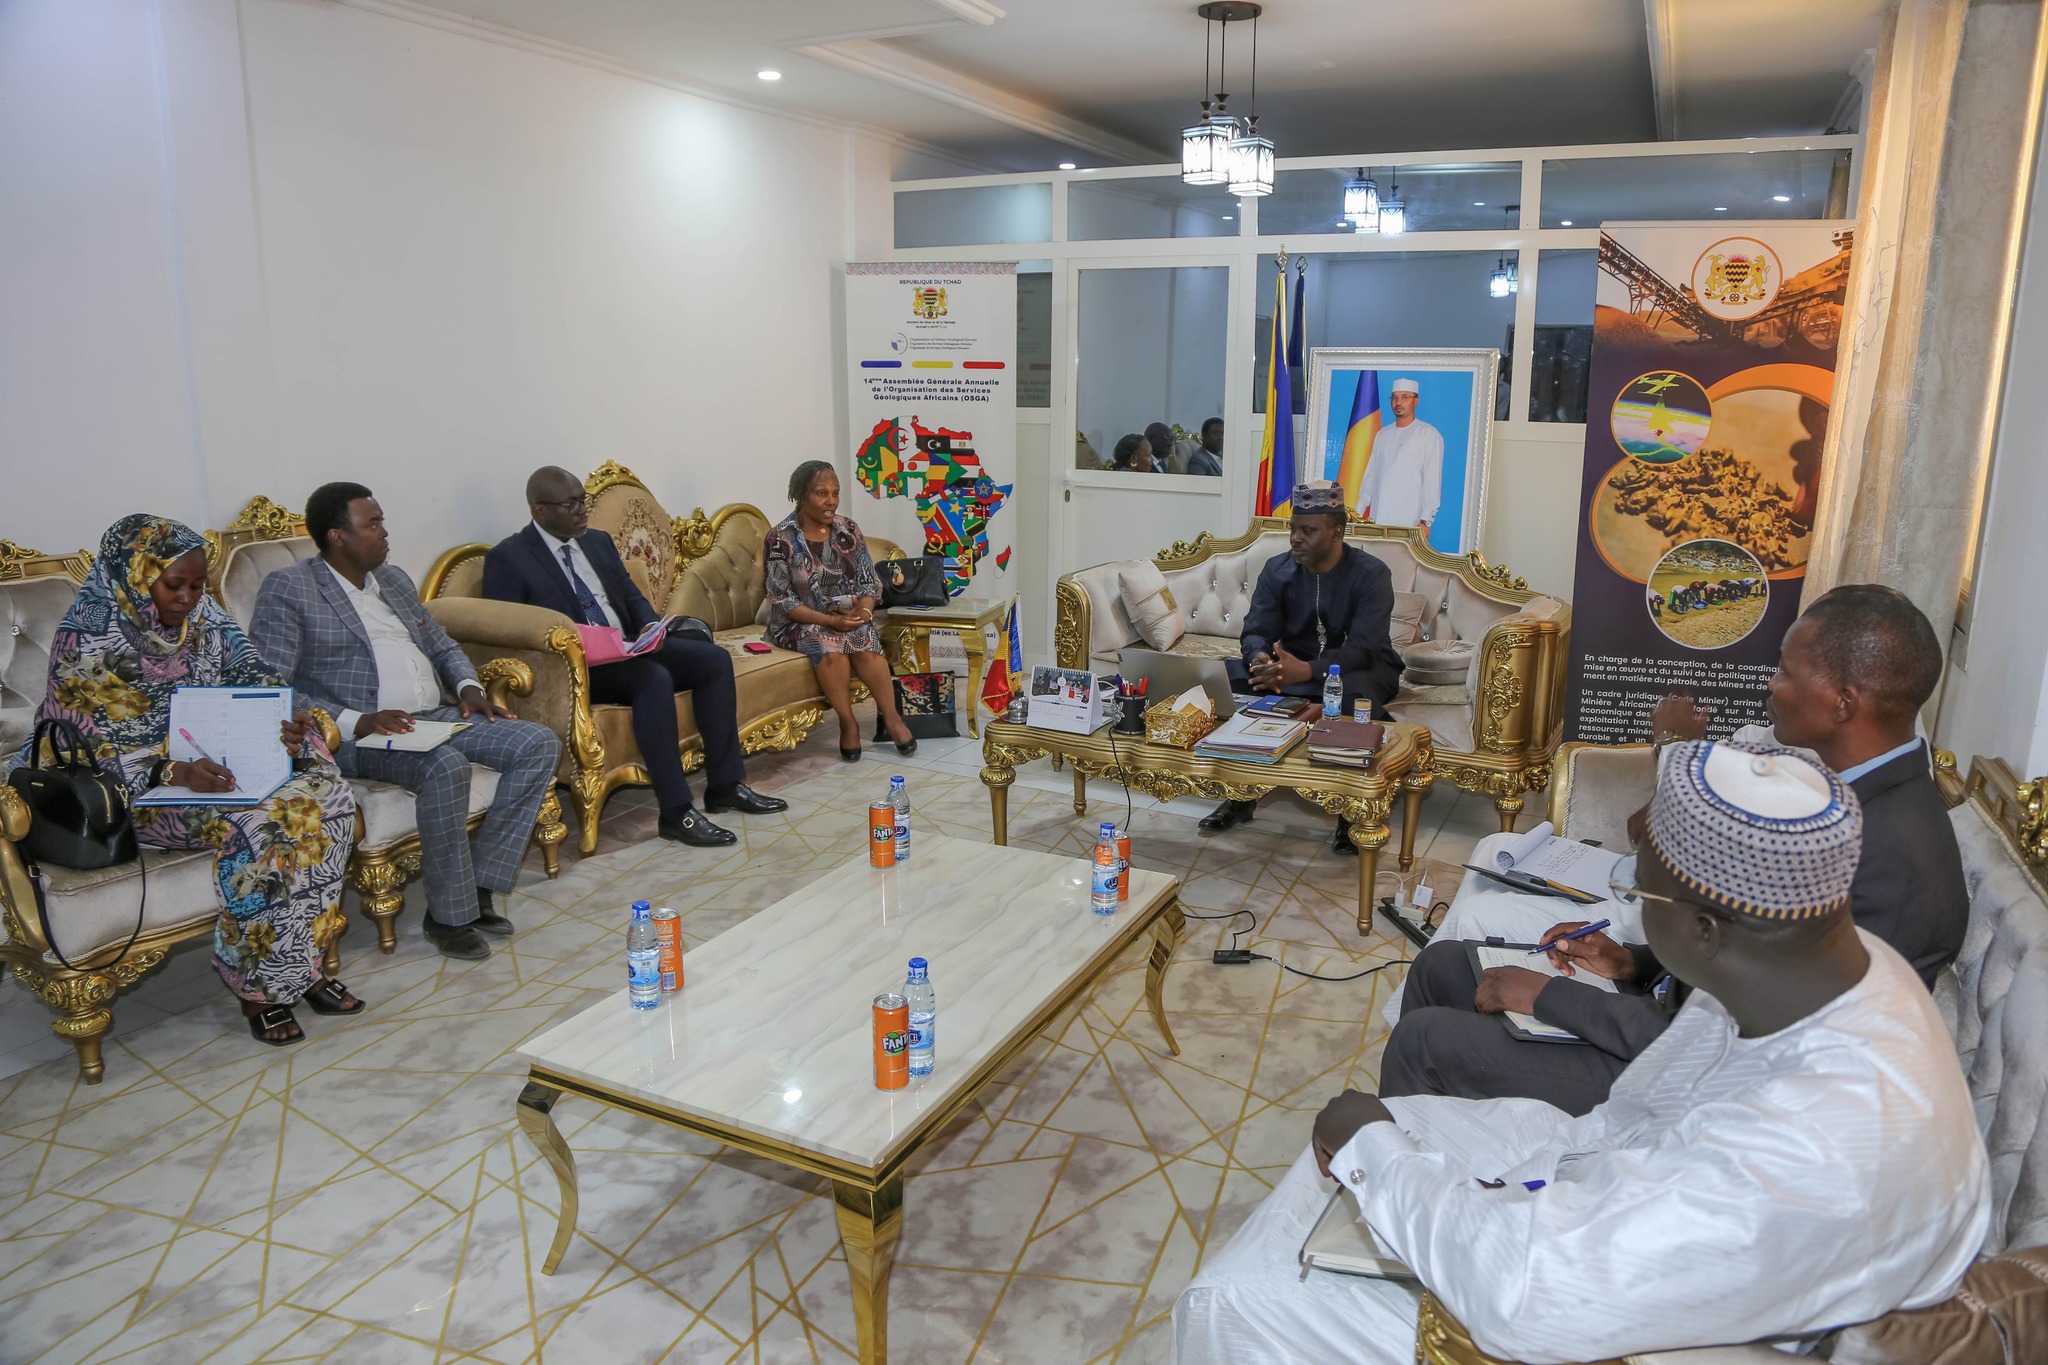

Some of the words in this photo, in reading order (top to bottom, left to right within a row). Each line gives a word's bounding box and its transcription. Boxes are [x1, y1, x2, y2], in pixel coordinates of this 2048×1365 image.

[884, 386, 938, 394] l'Organisation
[1598, 655, 1628, 665] charge
[1657, 660, 1708, 669] conception,
[1738, 664, 1780, 673] coordina
[1584, 663, 1604, 671] mise
[1718, 671, 1756, 681] politique
[1620, 674, 1652, 682] matière
[1667, 677, 1699, 687] pétrole,
[1719, 681, 1743, 689] Mines
[1581, 698, 1612, 706] Minière
[1693, 705, 1718, 713] fondé
[1698, 696, 1729, 706] Minier)
[1733, 700, 1763, 708] arrimé
[1580, 706, 1632, 717] économique
[1728, 717, 1770, 726] continent
[1580, 716, 1629, 725] exploitation
[1579, 724, 1624, 733] ressources
[1578, 733, 1610, 741] durable
